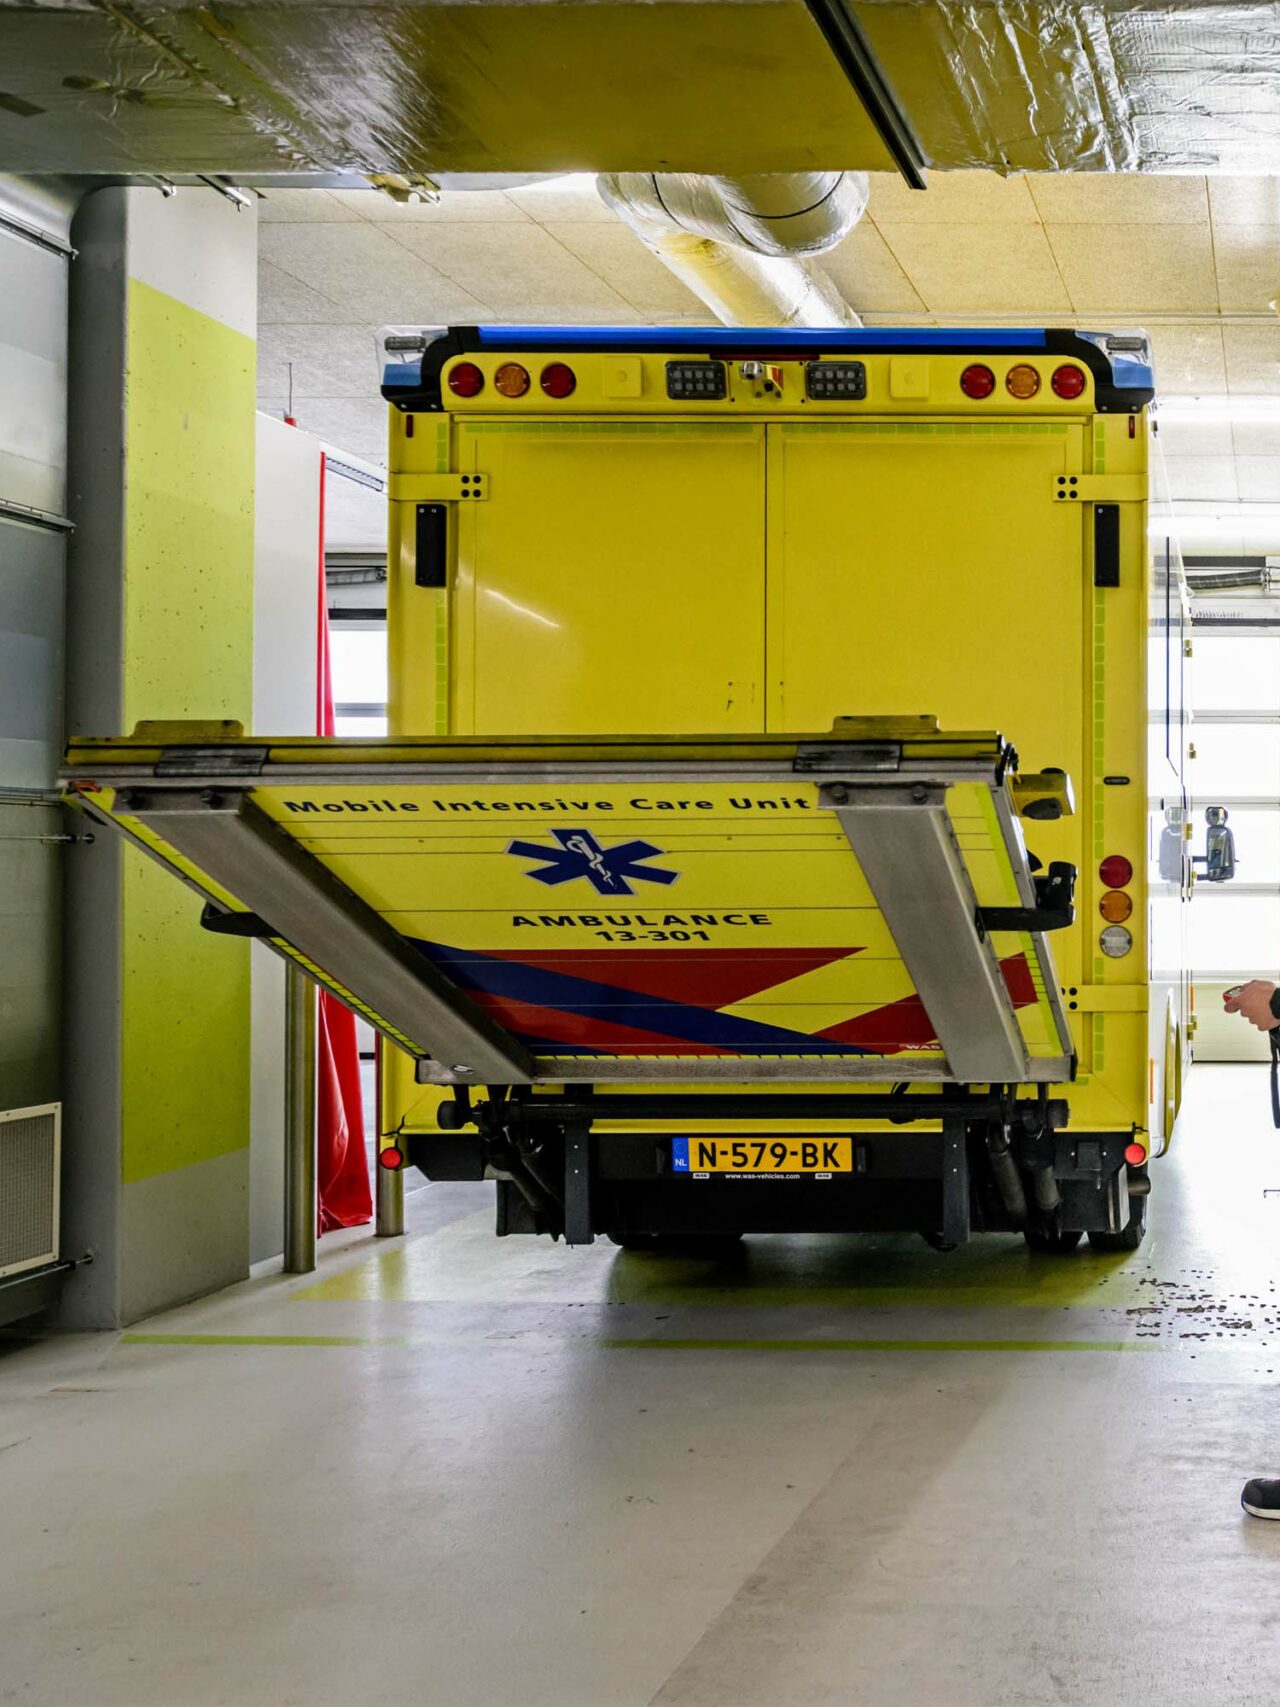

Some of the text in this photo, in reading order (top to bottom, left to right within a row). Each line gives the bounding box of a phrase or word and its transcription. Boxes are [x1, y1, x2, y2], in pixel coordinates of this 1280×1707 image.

[284, 797, 811, 812] Mobile Intensive Care Unit
[512, 914, 772, 926] AMBULANCE
[595, 930, 710, 941] 13-301
[698, 1142, 841, 1168] N-579-BK
[675, 1158, 687, 1167] NL
